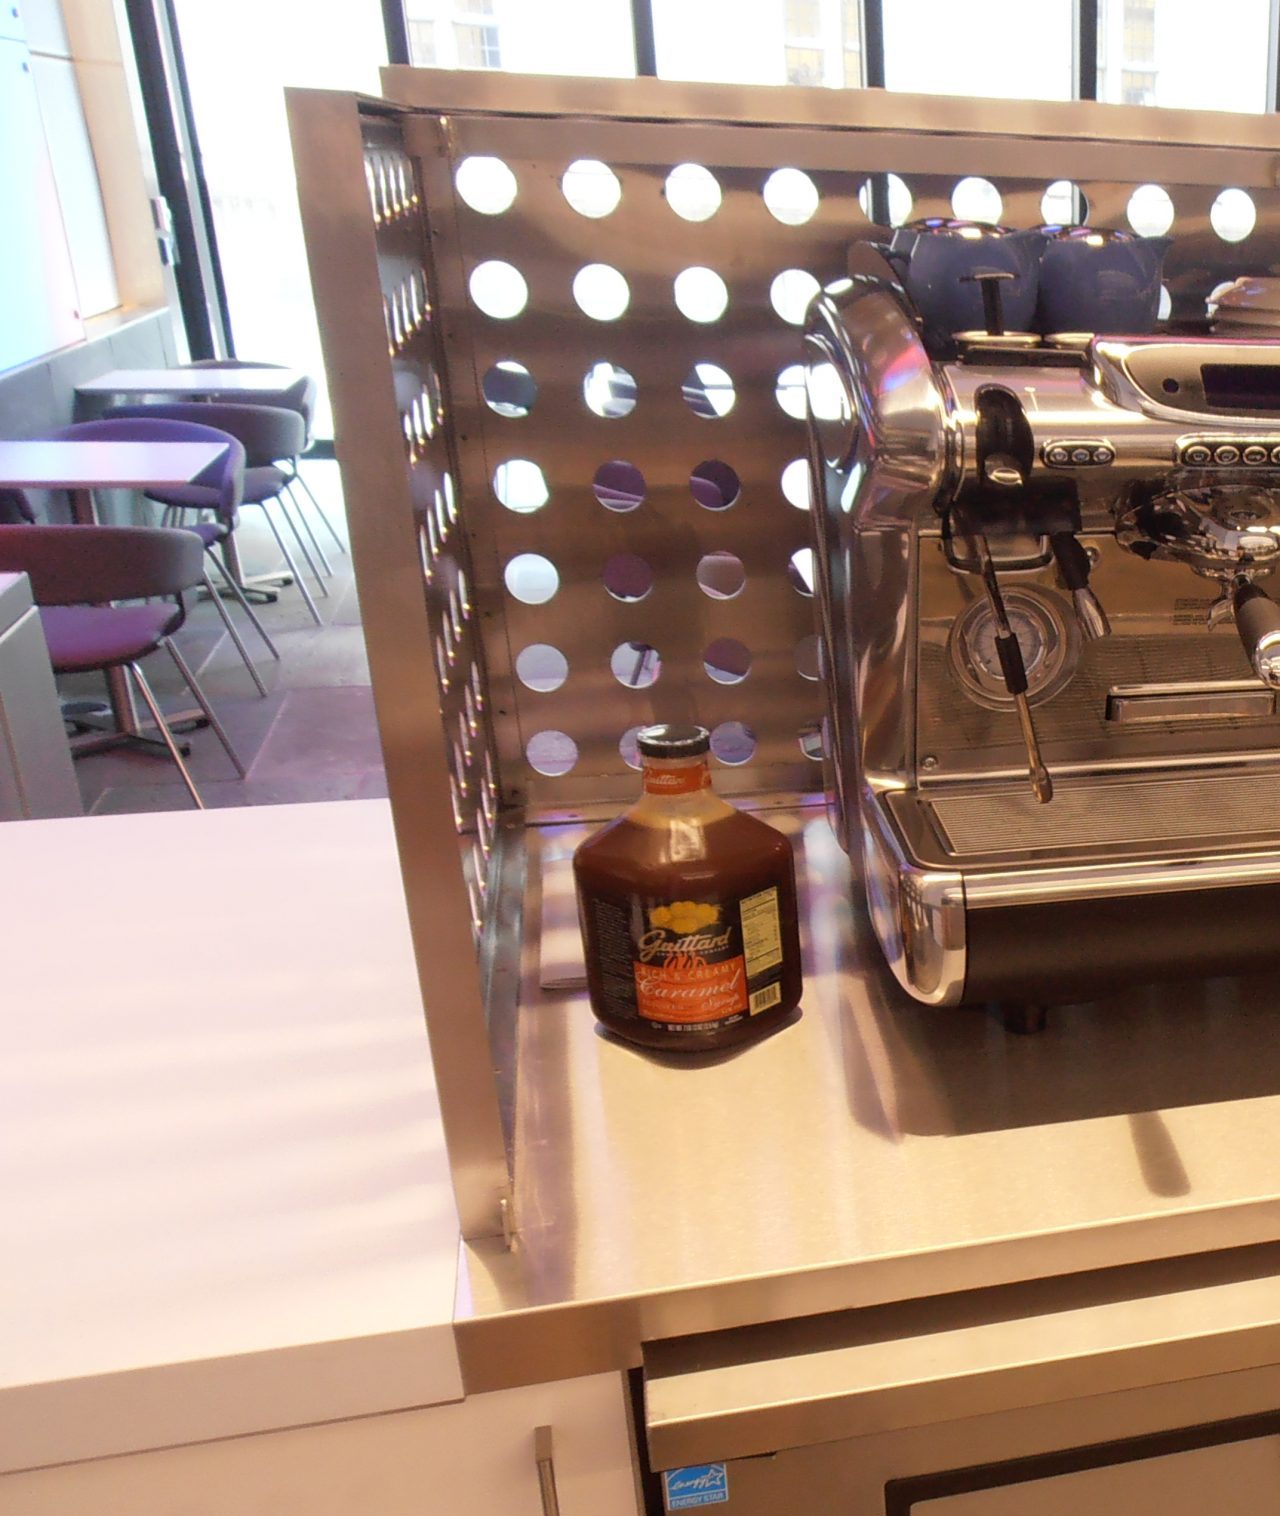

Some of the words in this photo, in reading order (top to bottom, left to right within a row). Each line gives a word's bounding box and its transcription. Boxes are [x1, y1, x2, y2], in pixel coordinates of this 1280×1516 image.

[639, 926, 733, 962] Guittard
[637, 967, 741, 998] Caramel
[687, 962, 736, 981] CREAMY
